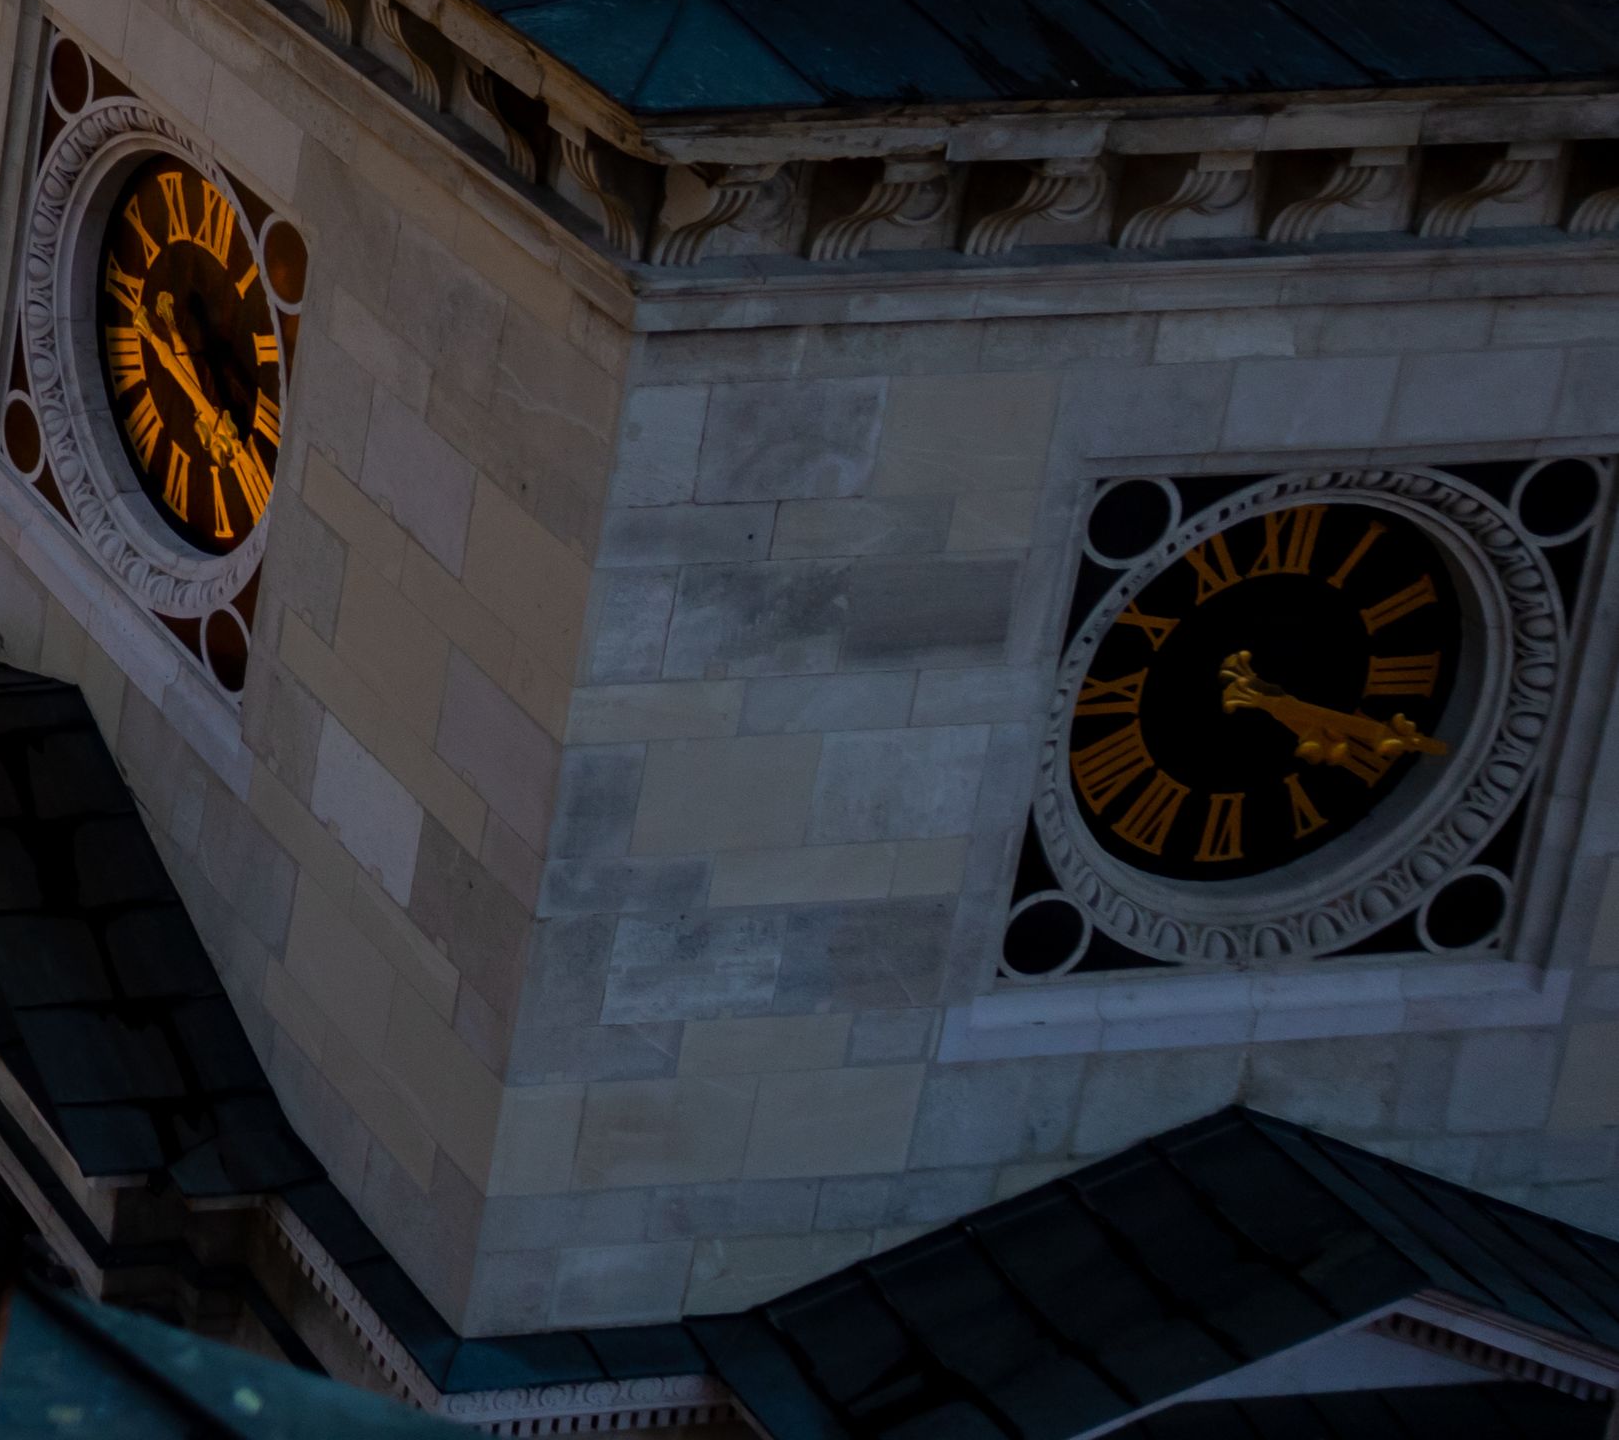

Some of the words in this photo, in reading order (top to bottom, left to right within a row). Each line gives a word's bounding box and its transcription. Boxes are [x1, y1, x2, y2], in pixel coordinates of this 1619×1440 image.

[124, 194, 160, 269] X
[157, 172, 191, 244] XI
[193, 178, 235, 269] XII
[1247, 505, 1328, 578] XII
[1327, 521, 1387, 590] I
[1359, 574, 1438, 635] II
[1362, 651, 1440, 698] III
[1194, 792, 1246, 862] VI
[1283, 773, 1329, 840] V
